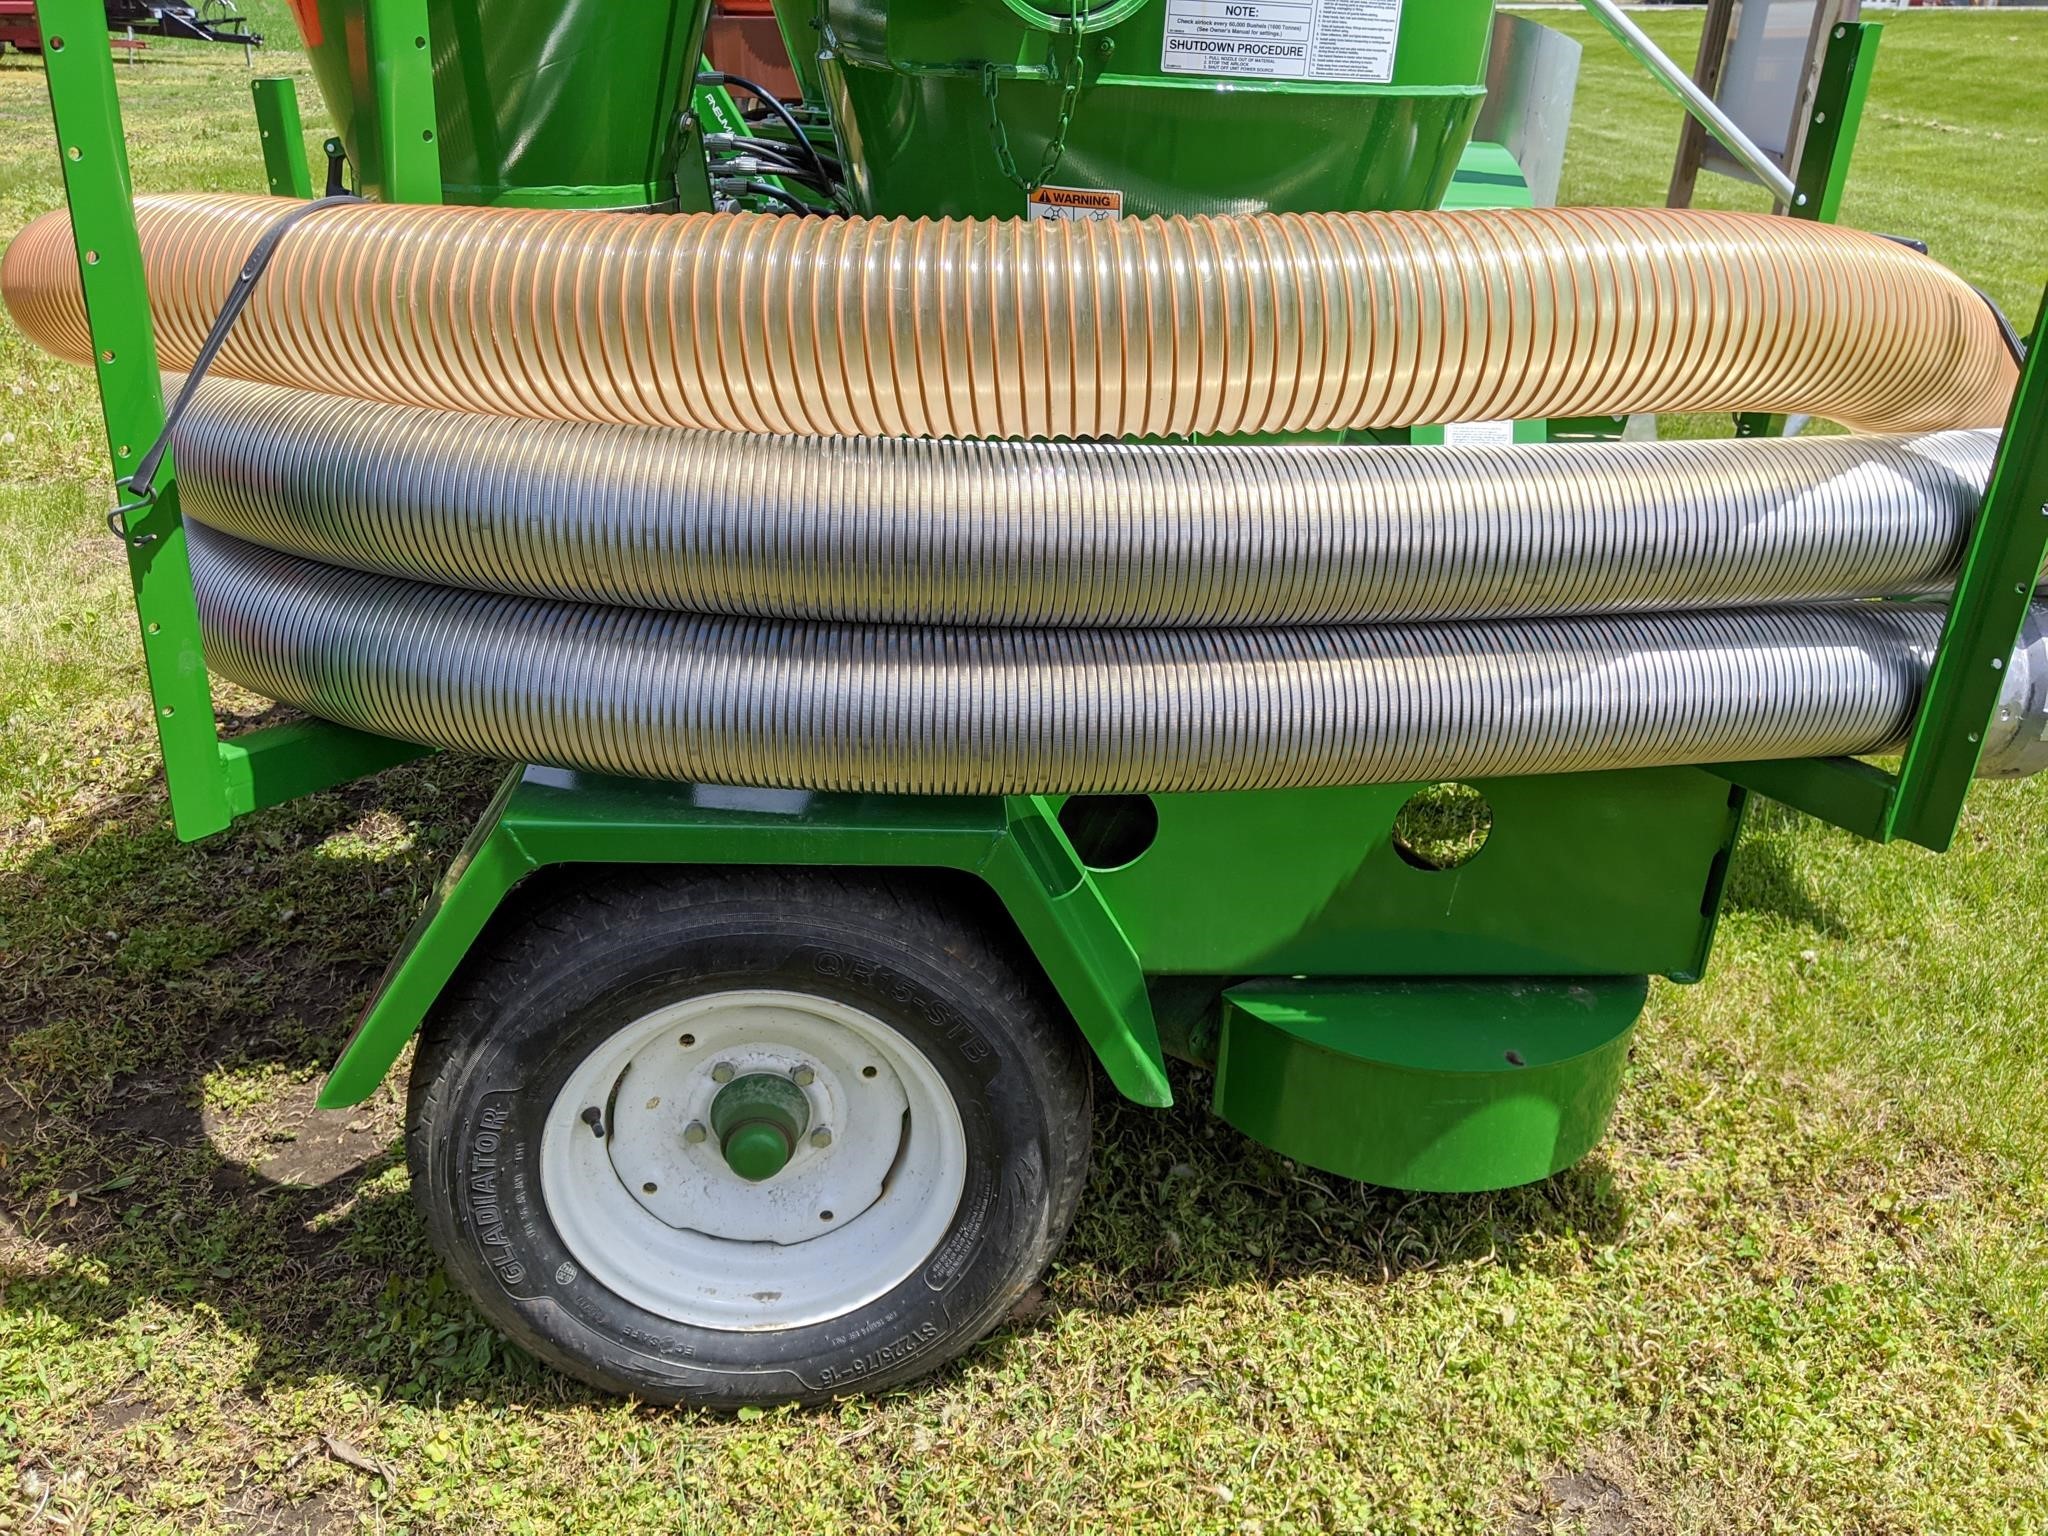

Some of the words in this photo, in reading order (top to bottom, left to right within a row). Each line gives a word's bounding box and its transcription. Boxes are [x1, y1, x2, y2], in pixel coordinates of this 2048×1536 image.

[1226, 6, 1259, 17] NOTE:
[1170, 40, 1234, 53] SHUTDOWN
[1238, 44, 1303, 56] PROCEDURE
[1053, 193, 1110, 206] WARNING
[471, 1107, 526, 1285] GLADIATOR
